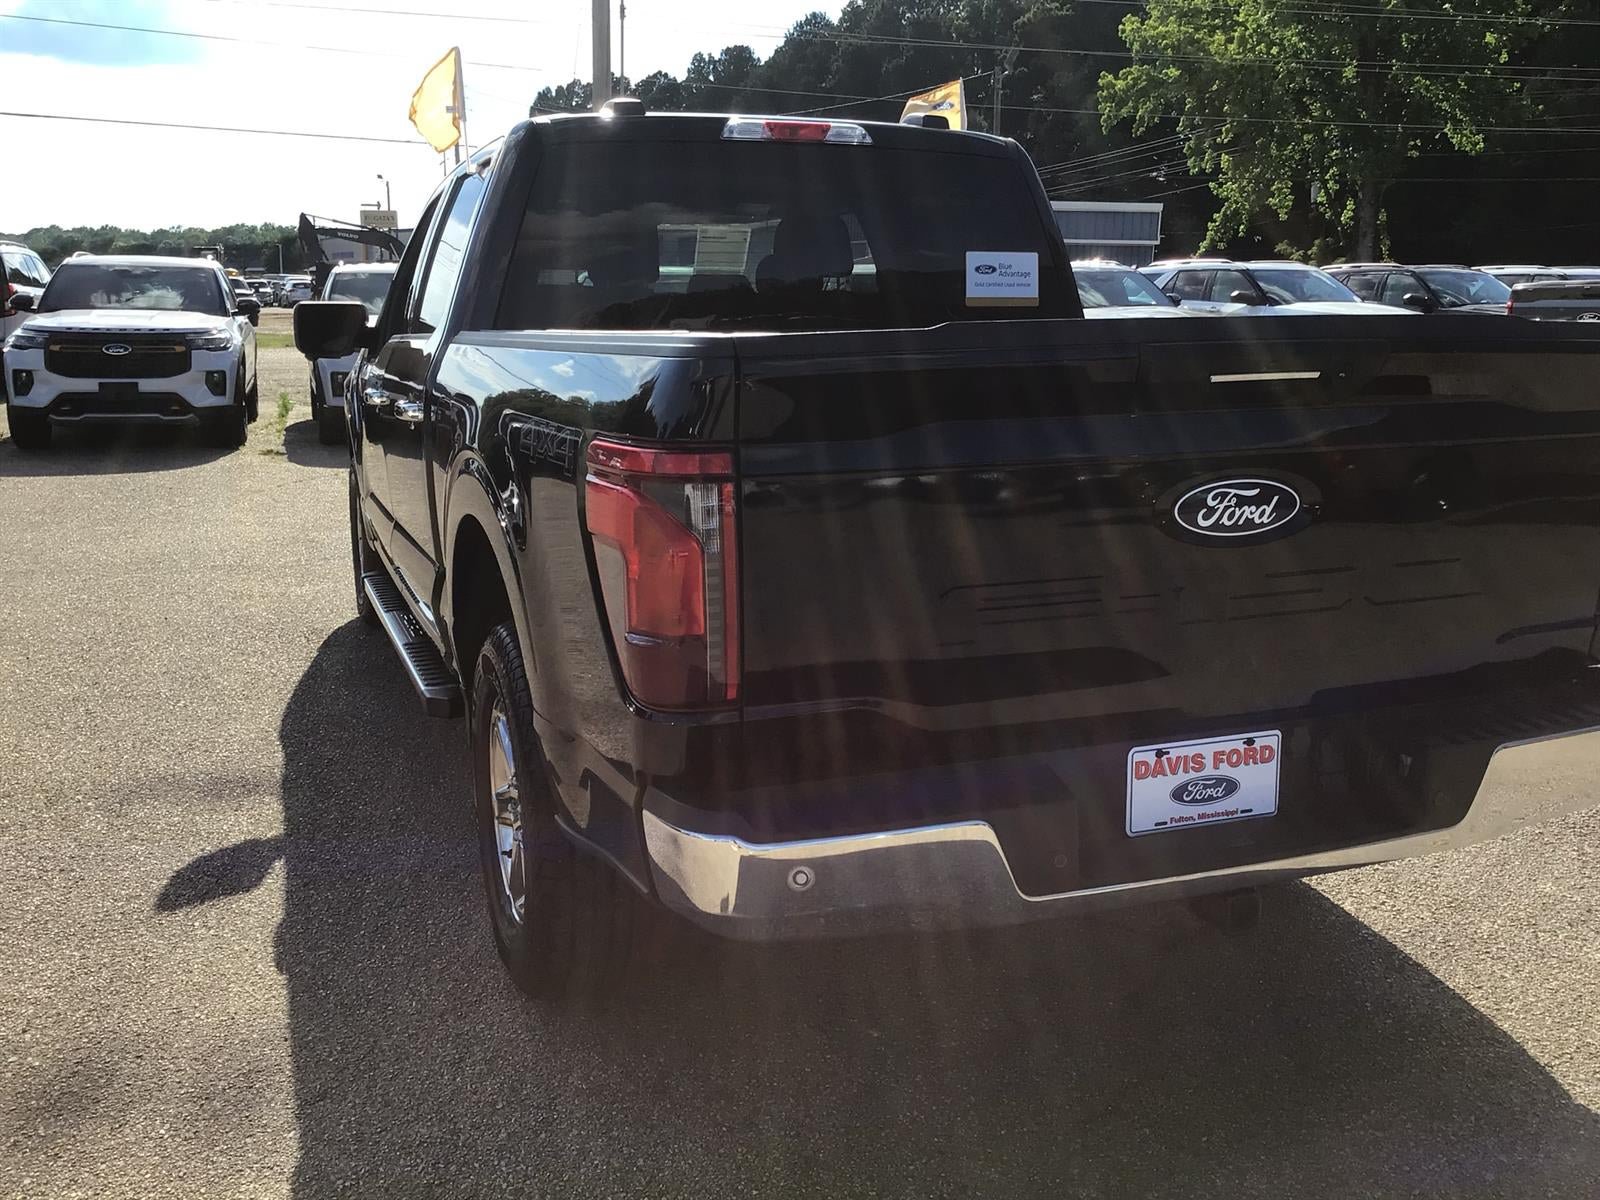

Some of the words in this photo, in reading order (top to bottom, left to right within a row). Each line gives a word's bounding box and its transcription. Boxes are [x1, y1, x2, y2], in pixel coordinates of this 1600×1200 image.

[337, 231, 359, 239] VOLVO
[1197, 488, 1279, 527] Ford
[1134, 753, 1206, 780] DAVIS
[1212, 744, 1276, 770] FORD
[1183, 779, 1226, 801] Ford
[1169, 815, 1196, 825] Fulton,
[1198, 808, 1239, 821] Mississippi
